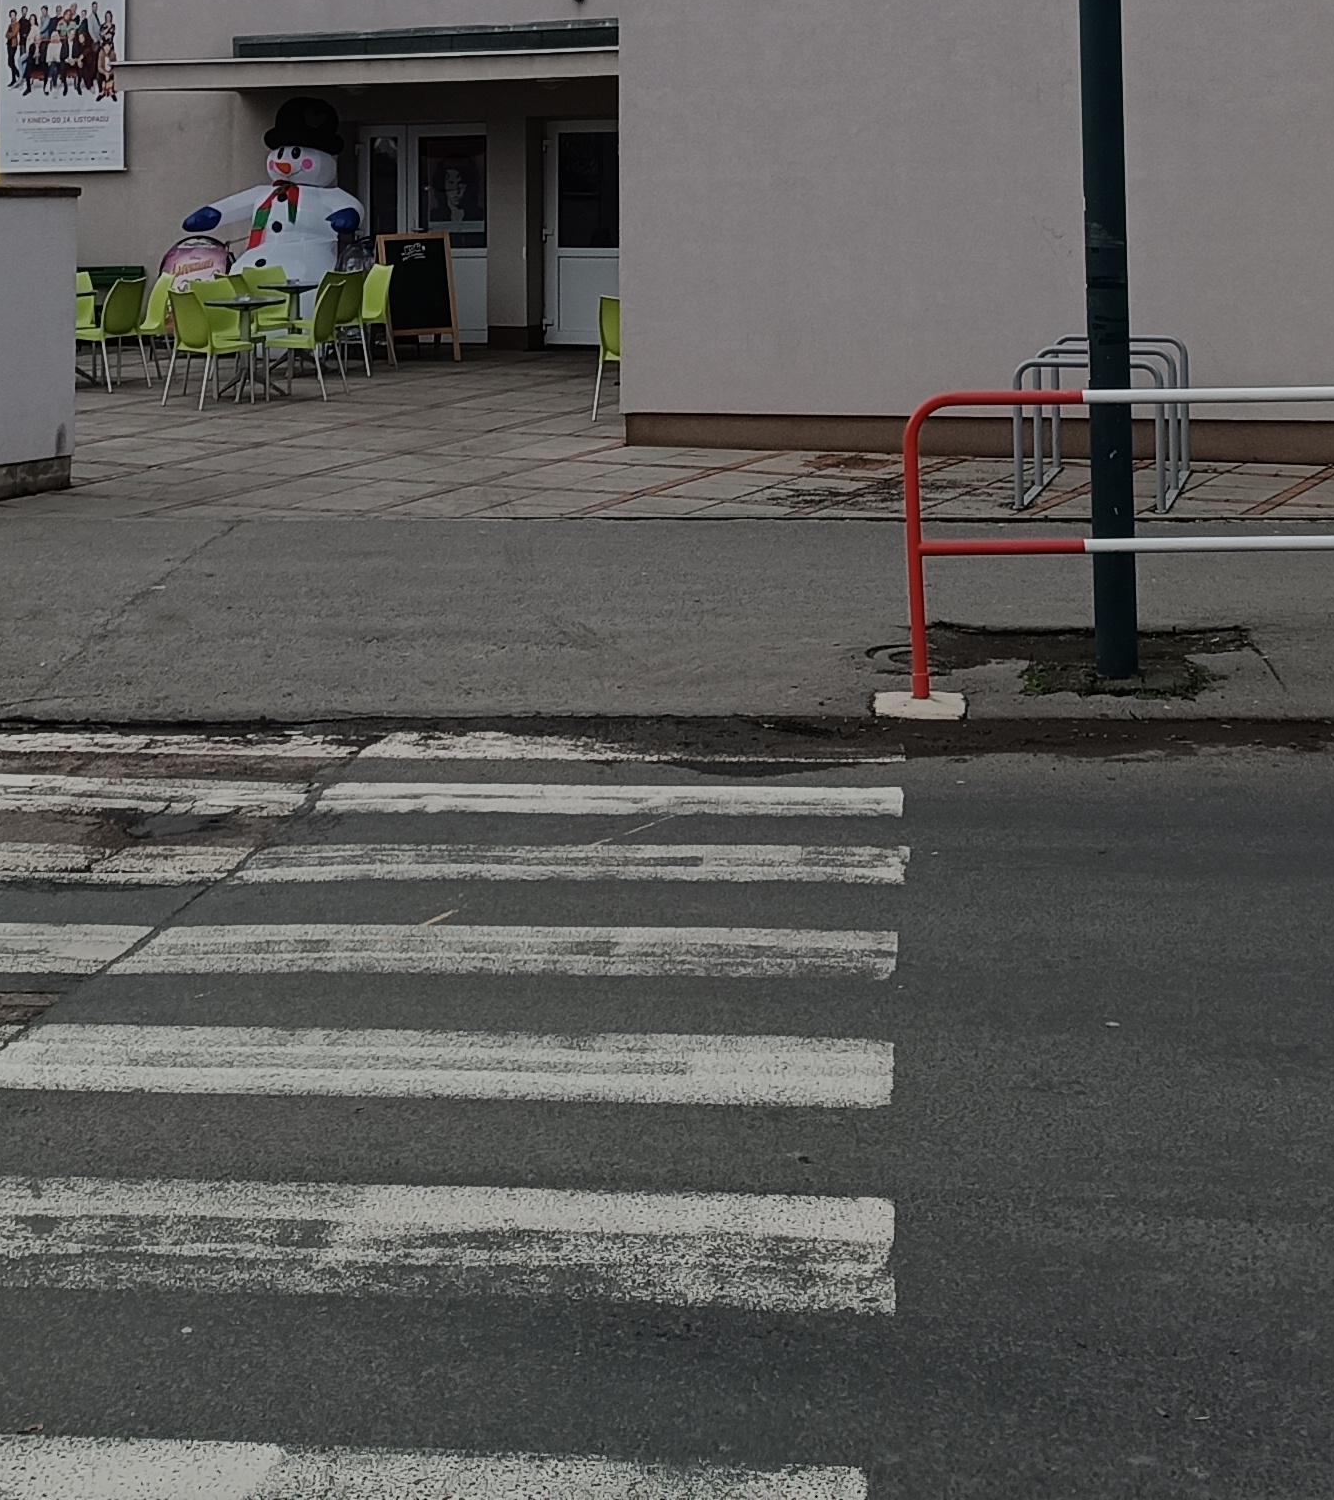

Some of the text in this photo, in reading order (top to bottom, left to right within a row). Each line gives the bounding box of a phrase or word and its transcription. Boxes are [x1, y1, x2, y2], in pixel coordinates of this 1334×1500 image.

[27, 116, 50, 124] KINECH
[51, 116, 62, 124] OD
[73, 115, 110, 123] LISTOPADU
